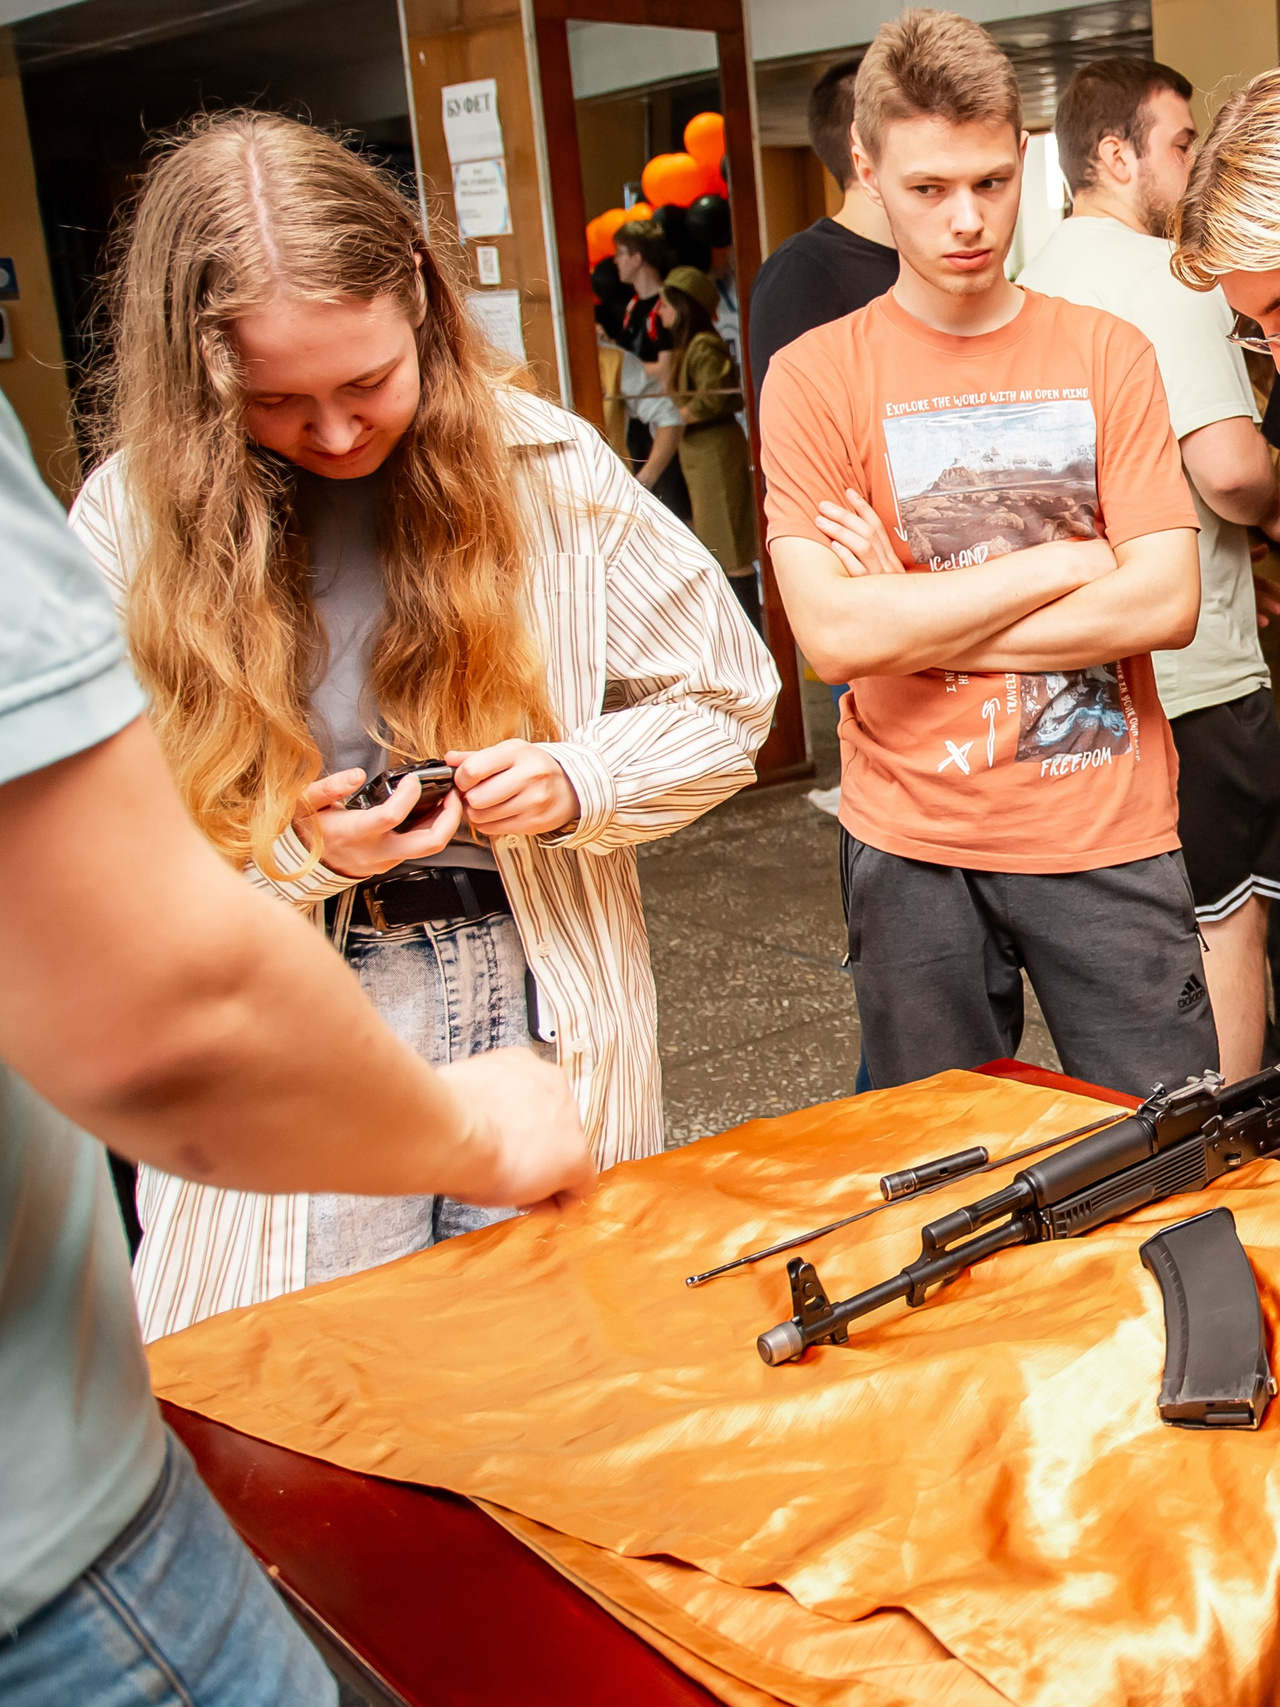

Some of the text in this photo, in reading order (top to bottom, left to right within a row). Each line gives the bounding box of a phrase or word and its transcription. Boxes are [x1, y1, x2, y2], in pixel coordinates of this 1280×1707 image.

[446, 92, 490, 118] БУФЕТ
[931, 396, 951, 409] THE
[953, 391, 988, 407] WORLD
[990, 390, 1017, 403] WITH
[1020, 390, 1033, 401] AN
[1035, 388, 1059, 400] OPEN
[1062, 387, 1089, 399] MIND
[1040, 746, 1112, 777] FREEDOM
[1177, 988, 1206, 1009] adidas
